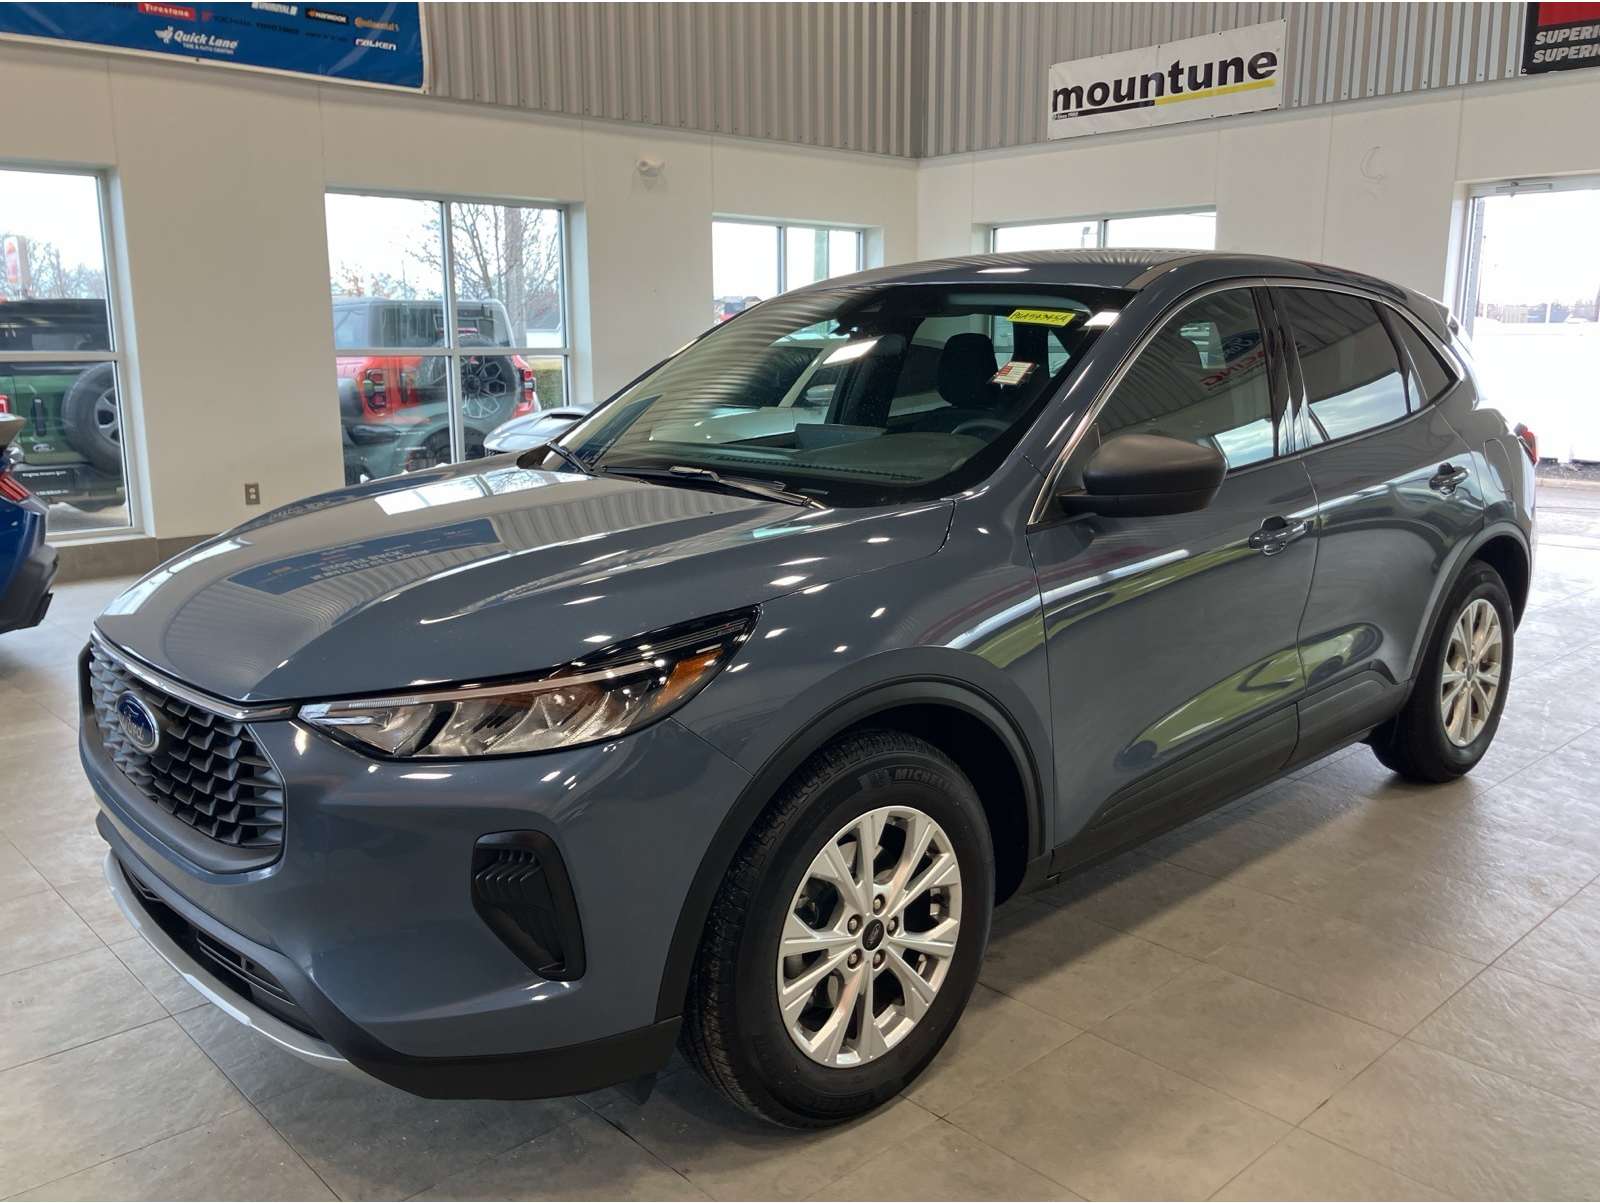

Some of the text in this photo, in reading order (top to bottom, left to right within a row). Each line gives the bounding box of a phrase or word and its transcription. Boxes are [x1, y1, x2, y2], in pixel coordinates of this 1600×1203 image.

[174, 30, 238, 49] Quick Lane
[355, 38, 397, 51] FALKEN
[1534, 25, 1600, 46] SUPERI
[1052, 51, 1278, 112] mountune
